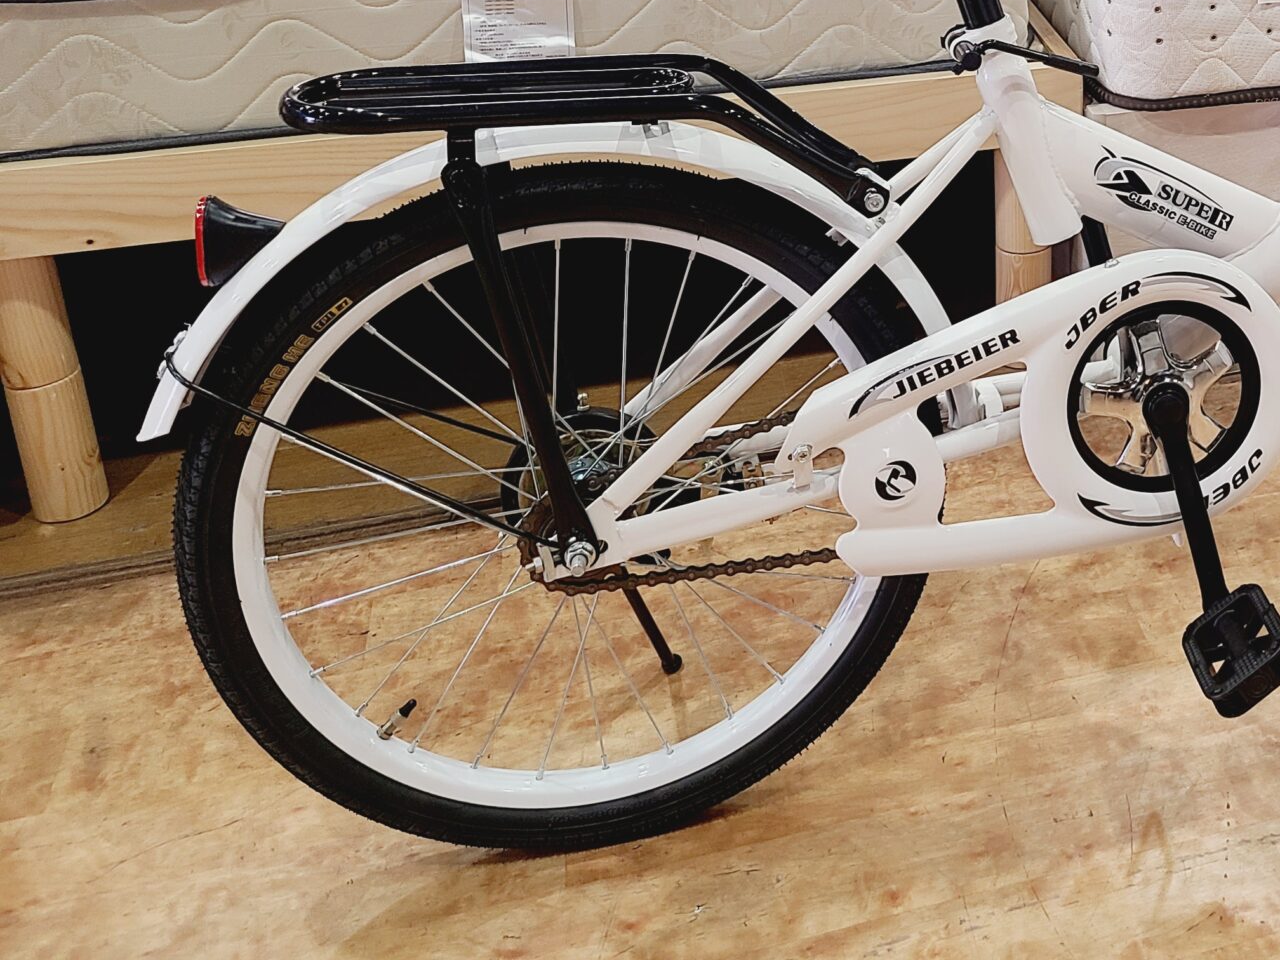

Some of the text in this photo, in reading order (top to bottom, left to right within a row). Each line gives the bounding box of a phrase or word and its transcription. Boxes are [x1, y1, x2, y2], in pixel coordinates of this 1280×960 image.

[1128, 192, 1217, 240] CLASSIC E-BIKE
[1157, 183, 1234, 231] SUPER
[1065, 280, 1142, 350] JBER
[892, 328, 1021, 399] JIEBEIER
[1203, 448, 1263, 509] JBE
